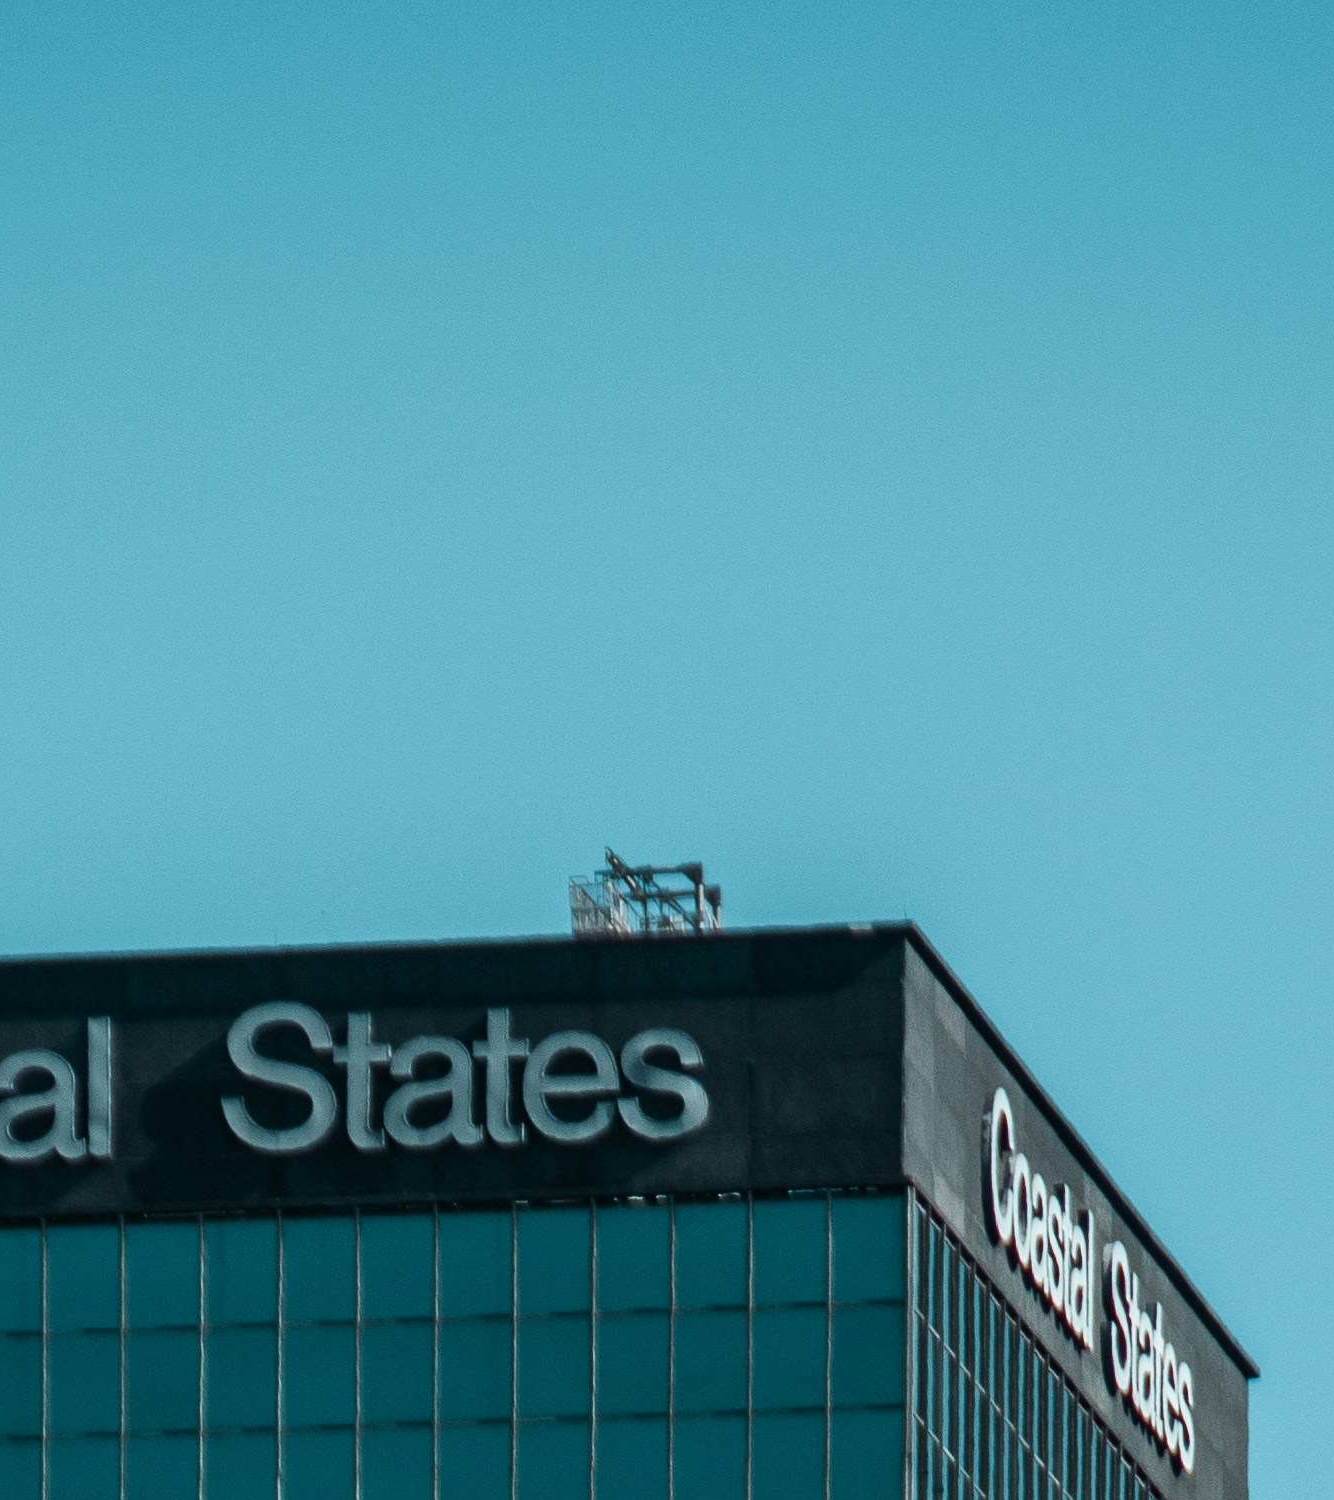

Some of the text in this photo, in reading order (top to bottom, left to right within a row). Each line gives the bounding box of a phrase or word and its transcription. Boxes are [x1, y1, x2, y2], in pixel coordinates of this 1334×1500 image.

[221, 1003, 710, 1151] States
[988, 1086, 1195, 1475] Coastal States
